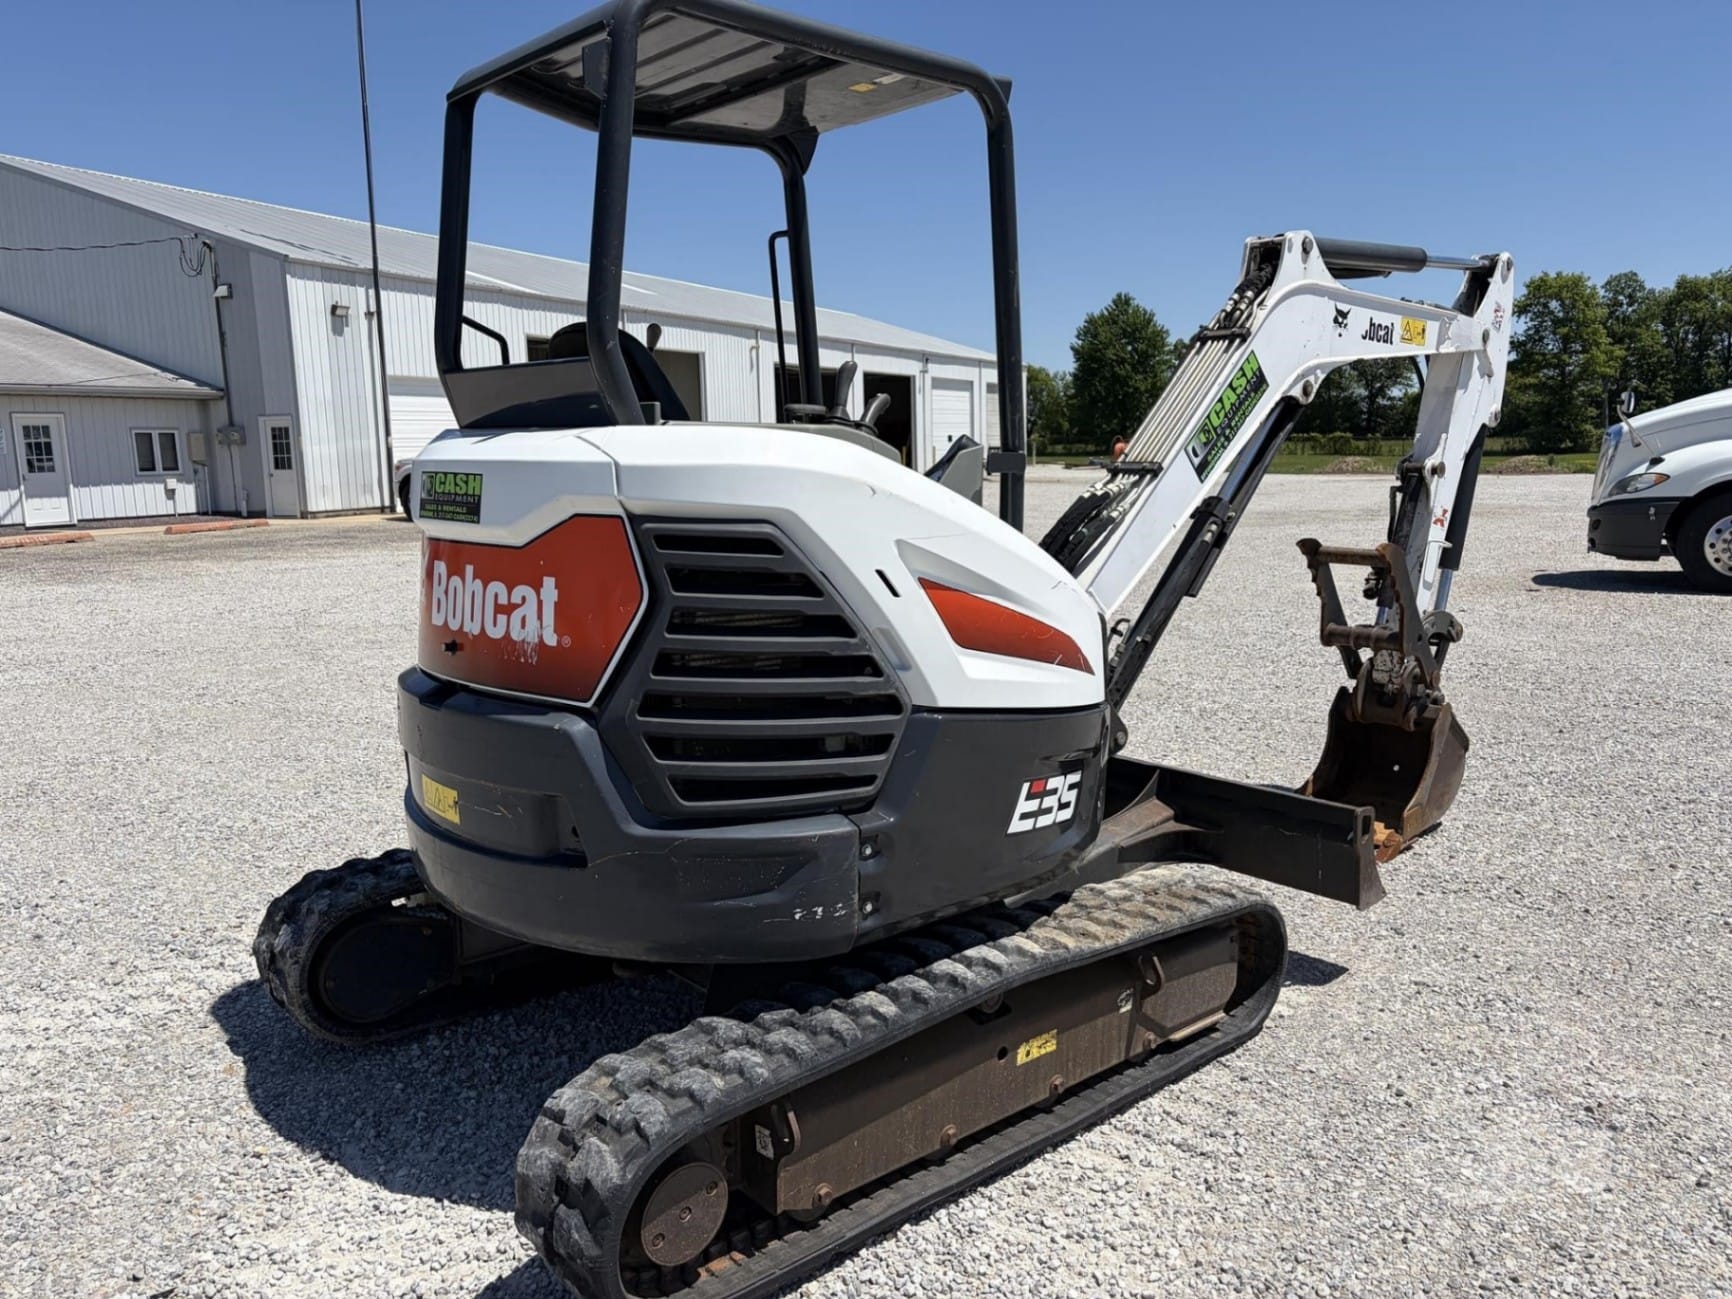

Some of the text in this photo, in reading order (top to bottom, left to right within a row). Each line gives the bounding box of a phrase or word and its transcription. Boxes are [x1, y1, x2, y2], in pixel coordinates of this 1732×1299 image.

[1208, 352, 1259, 428] CASH
[435, 473, 481, 495] CASH
[435, 493, 479, 503] EQUIPMENT
[431, 560, 558, 647] Bobcat
[1007, 770, 1082, 834] E35
